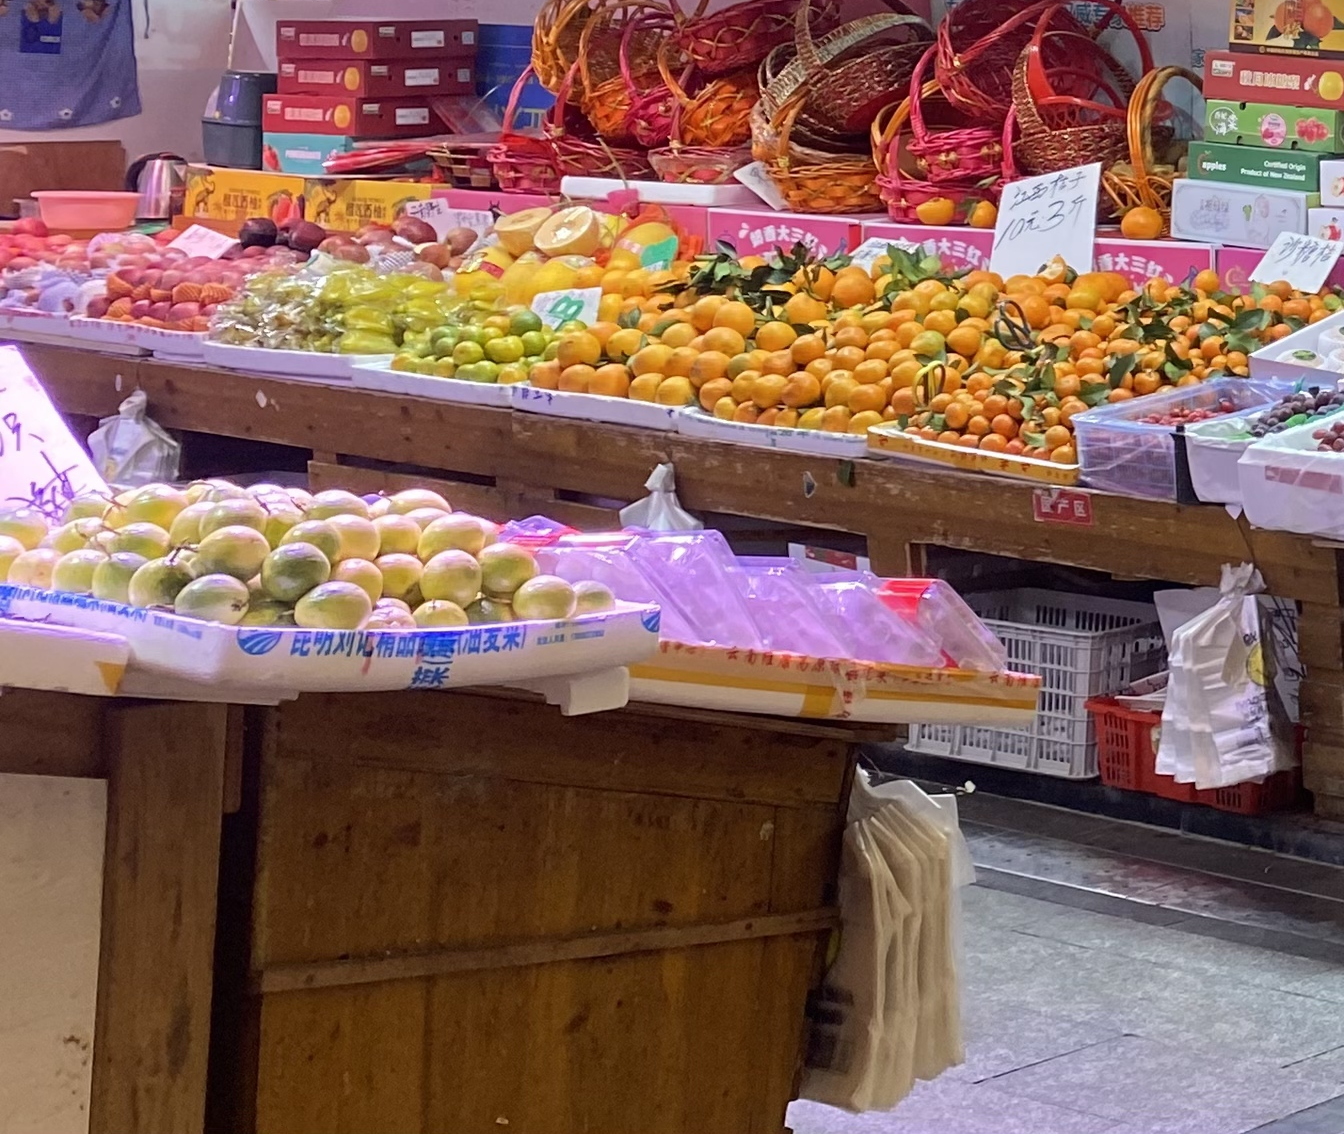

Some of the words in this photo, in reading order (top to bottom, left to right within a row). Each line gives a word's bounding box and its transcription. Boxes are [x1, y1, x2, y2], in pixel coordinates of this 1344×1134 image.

[1202, 160, 1227, 171] apples
[1264, 160, 1288, 170] Certified
[1240, 168, 1263, 177] Product
[1283, 173, 1306, 181] Zealand
